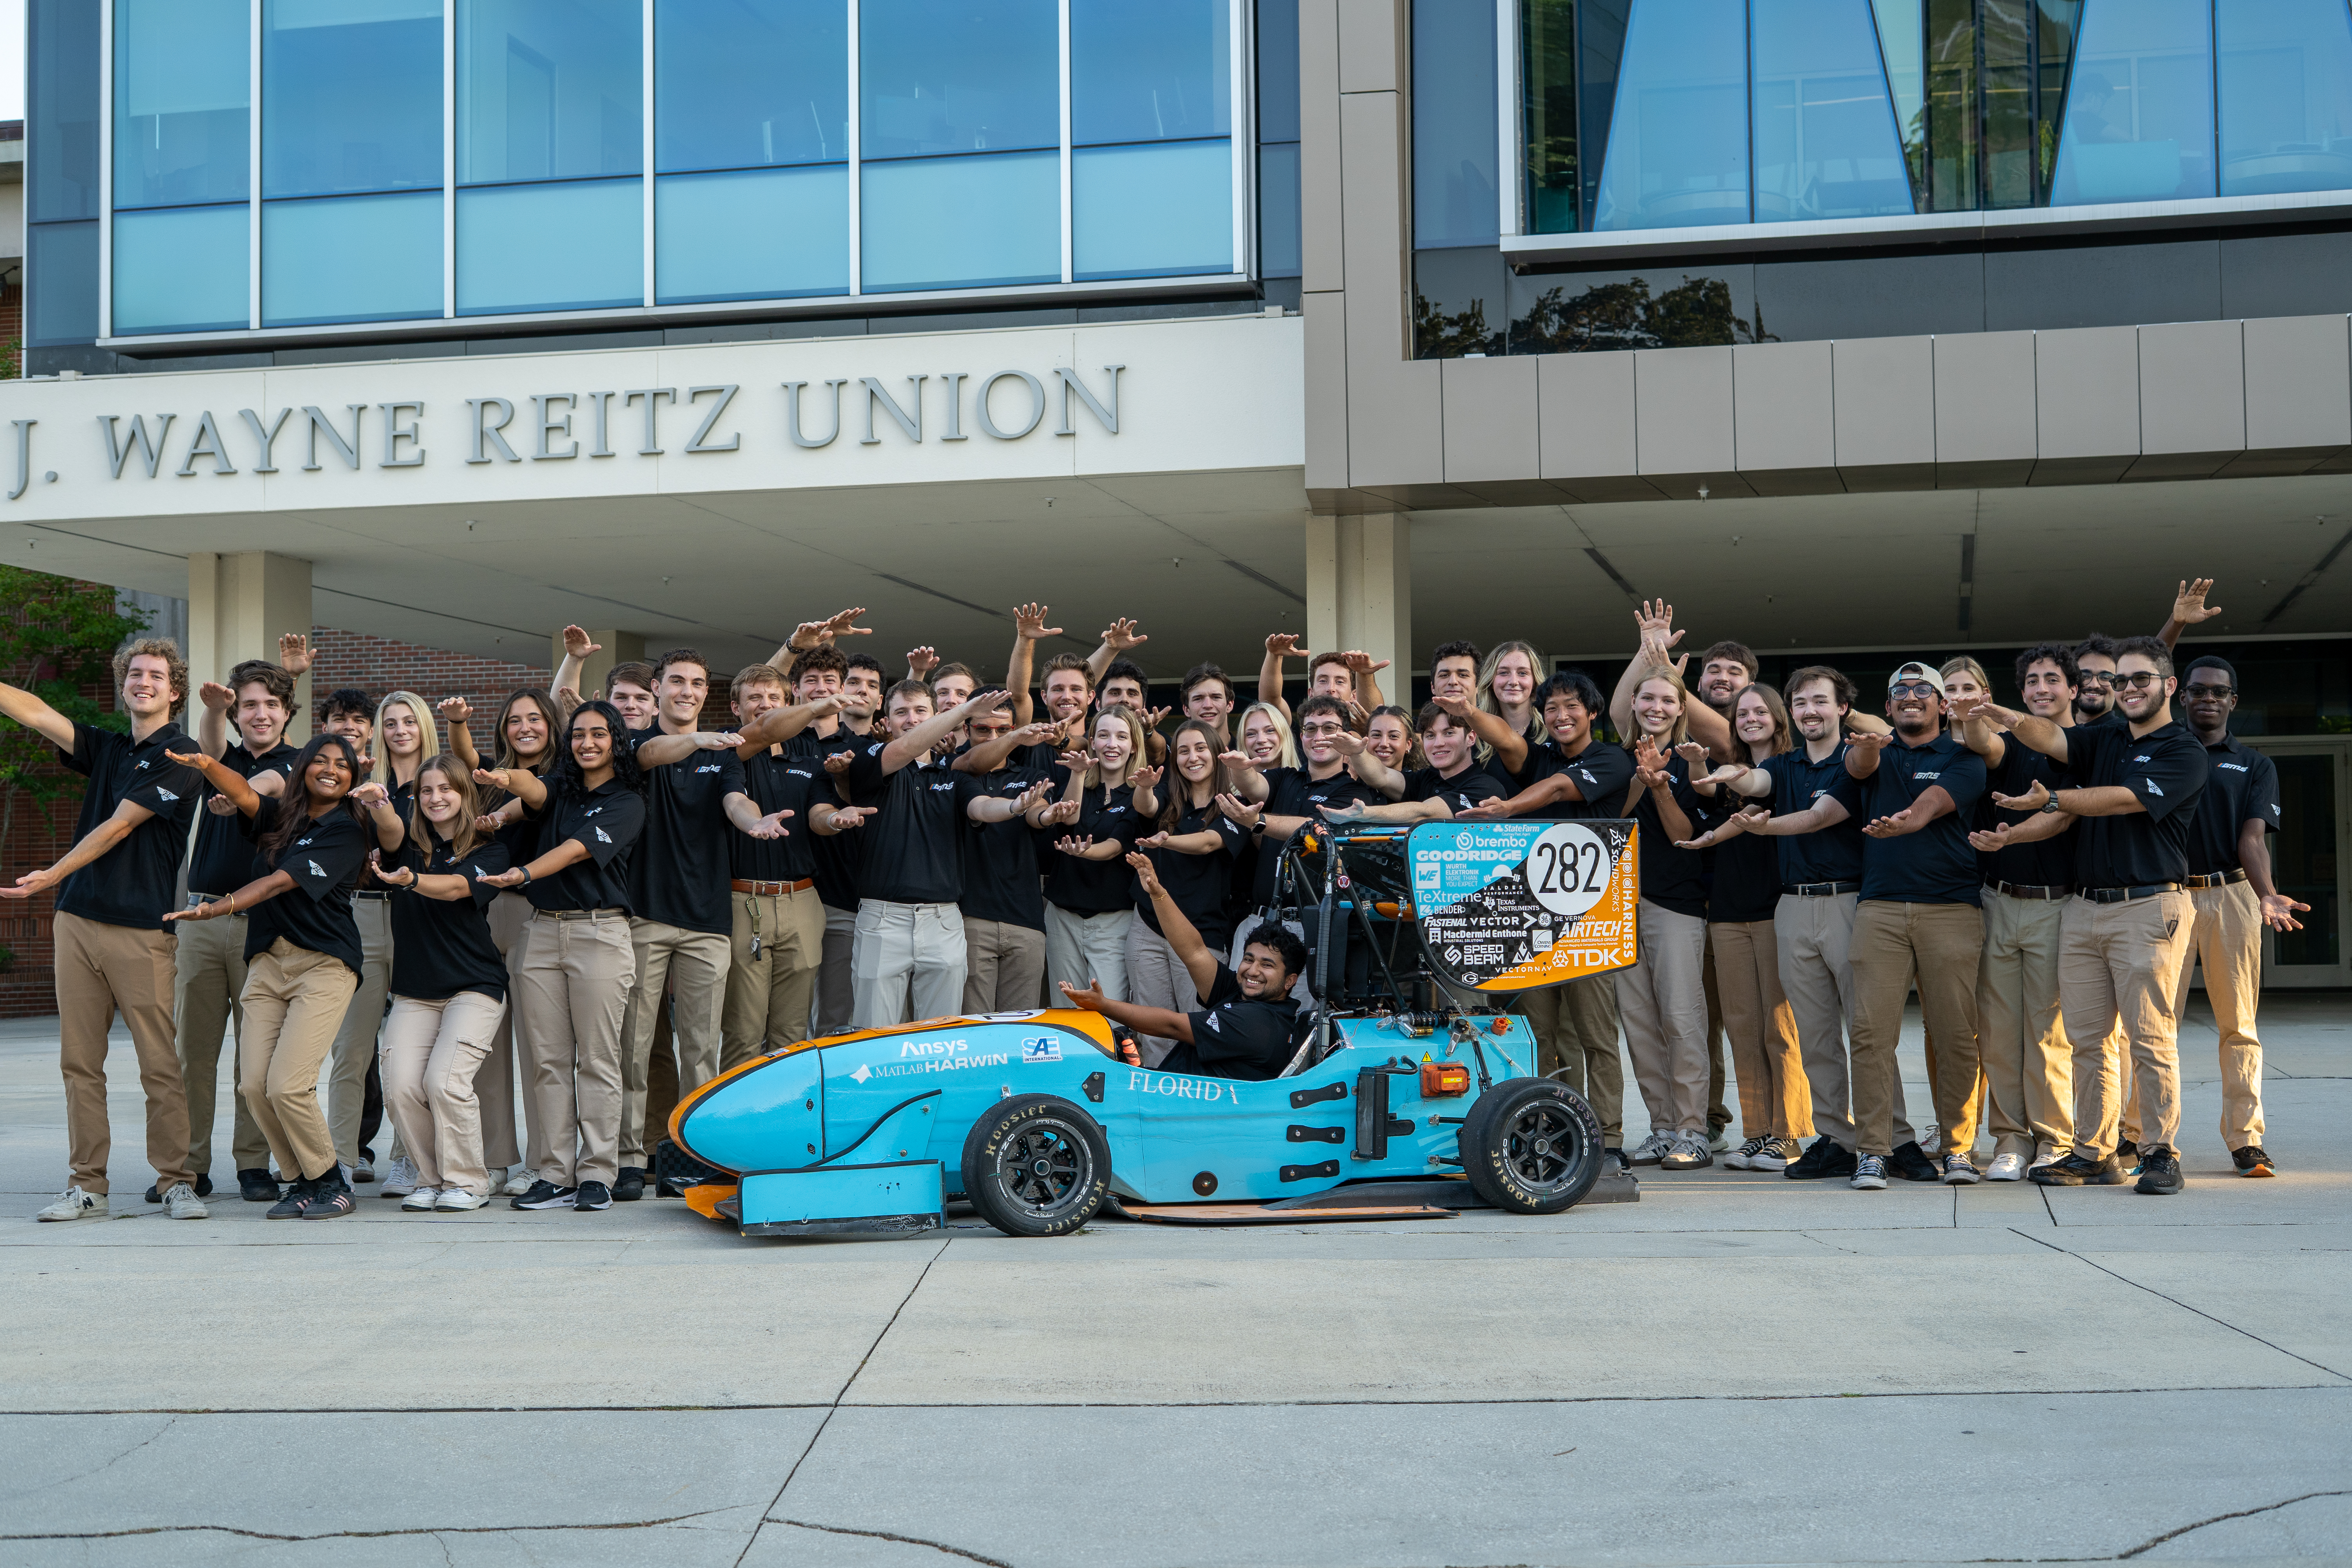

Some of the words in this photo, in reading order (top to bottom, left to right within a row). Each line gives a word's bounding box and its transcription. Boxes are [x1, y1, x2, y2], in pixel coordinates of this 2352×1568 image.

[8, 419, 58, 501] J.
[96, 401, 426, 479] WAYNE
[465, 384, 740, 464] REITZ
[780, 365, 1126, 448] UNION
[1476, 835, 1527, 847] brembo
[1416, 849, 1522, 861] GOODRIDGE
[1537, 842, 1601, 893] 282
[1419, 870, 1438, 881] WE
[1611, 849, 1619, 912] SOLIDWORKS
[1416, 890, 1482, 902] TeXtreme
[1434, 905, 1463, 915] BENDER
[1424, 916, 1468, 927] FASTENAL
[1470, 916, 1519, 926] VECTOR
[1443, 929, 1491, 938] MacDermid
[1492, 929, 1527, 938] Enthone
[1558, 920, 1622, 938] AIRTECH
[1464, 944, 1504, 954] SPEED
[1464, 954, 1504, 965] BEAM
[1567, 948, 1622, 967] TDK
[900, 1040, 968, 1057] Ansys
[1023, 1038, 1059, 1056] SAE
[875, 1064, 924, 1078] MATLAB
[985, 1104, 1046, 1157] Hoosier
[1576, 1117, 1586, 1136] RACING
[1504, 1159, 1515, 1178] RACING
[1491, 1150, 1540, 1207] Hoosier
